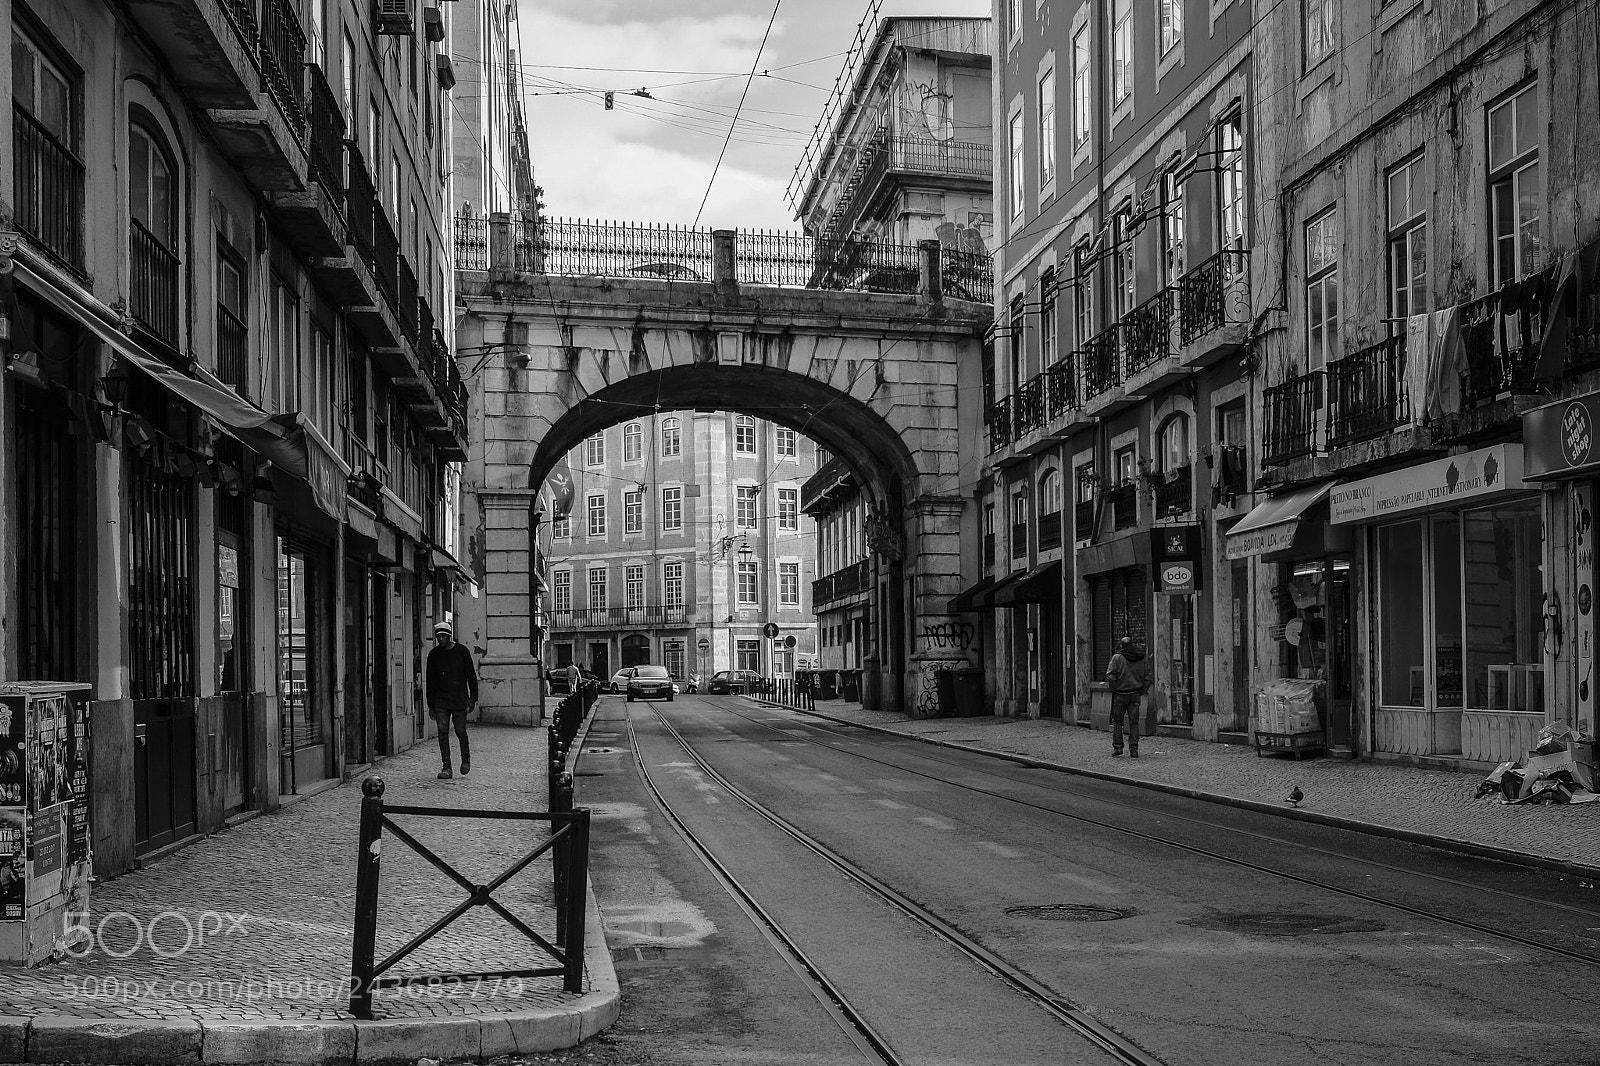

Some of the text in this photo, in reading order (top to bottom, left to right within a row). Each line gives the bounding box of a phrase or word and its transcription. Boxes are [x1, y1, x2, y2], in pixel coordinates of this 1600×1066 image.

[1564, 408, 1580, 432] Late
[1567, 416, 1586, 448] night
[1572, 434, 1589, 461] shop
[1167, 571, 1188, 580] bdo
